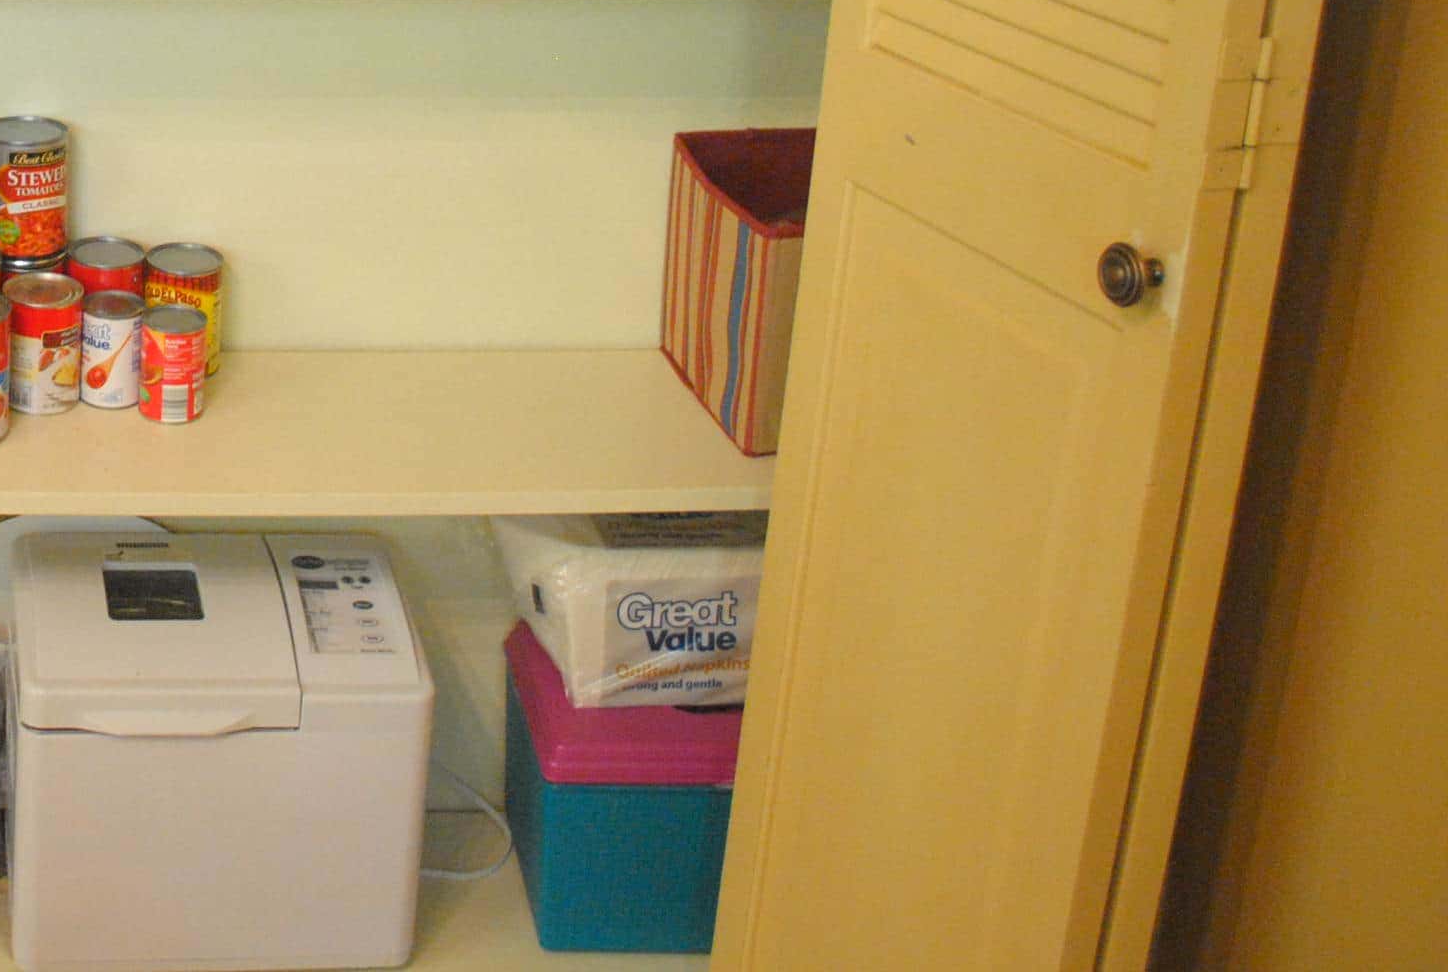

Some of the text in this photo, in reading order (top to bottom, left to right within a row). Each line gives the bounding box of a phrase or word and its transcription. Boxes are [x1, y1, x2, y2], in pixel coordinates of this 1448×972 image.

[7, 166, 66, 186] STEWE
[83, 334, 110, 350] alue
[617, 589, 739, 631] Great
[645, 626, 737, 653] Value
[661, 679, 684, 690] and
[685, 679, 723, 691] gentle
